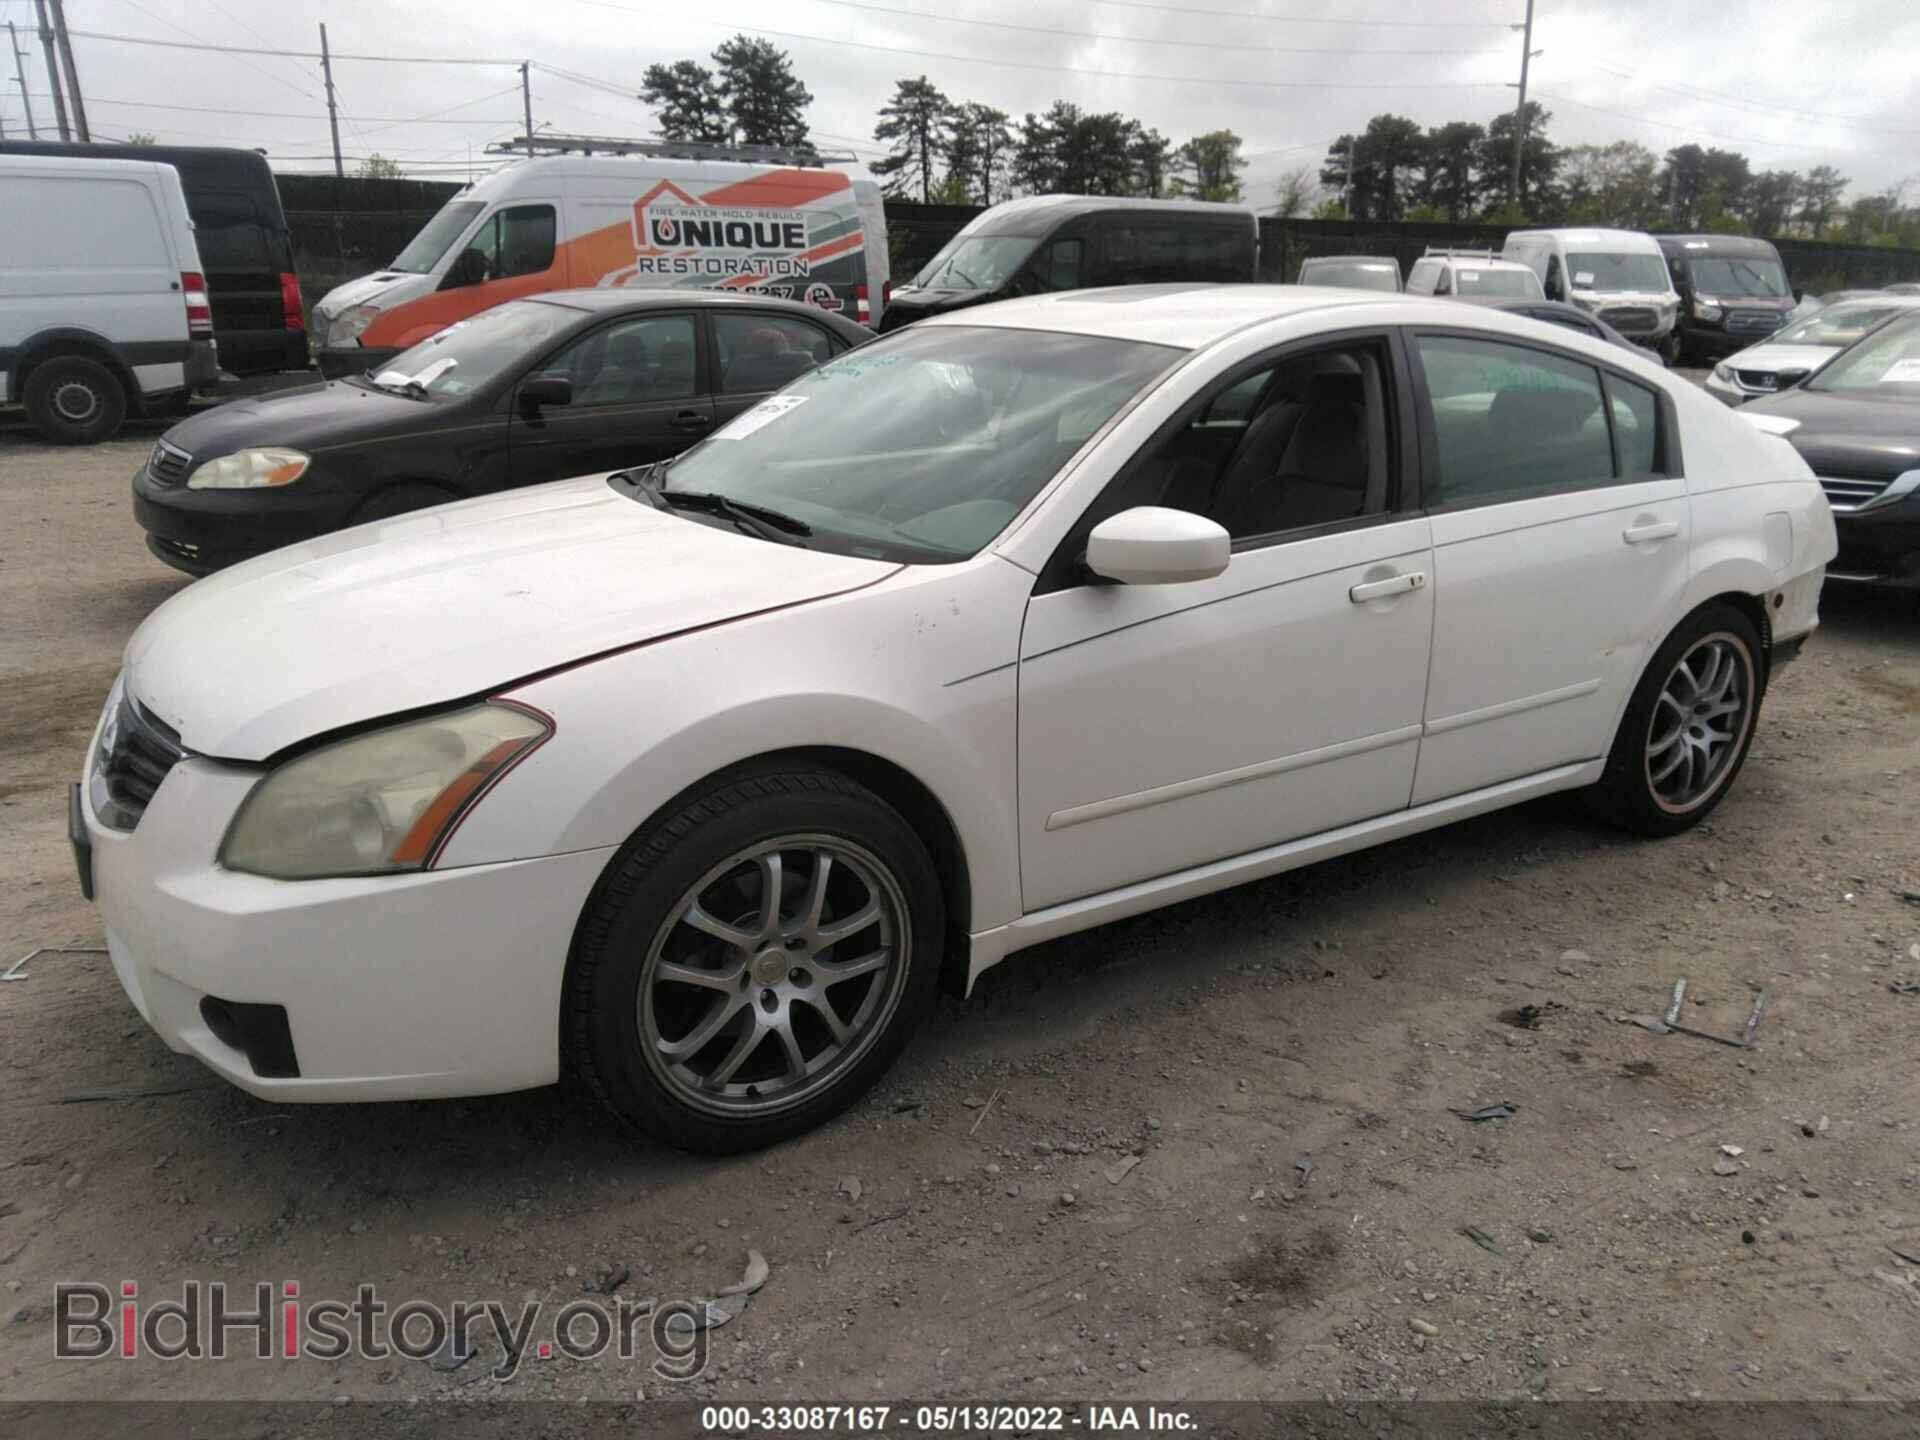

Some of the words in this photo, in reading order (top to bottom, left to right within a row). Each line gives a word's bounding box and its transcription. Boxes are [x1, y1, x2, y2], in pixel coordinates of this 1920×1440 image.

[650, 208, 673, 216] FIRE
[681, 208, 717, 217] WATER
[723, 209, 753, 218] MOLD
[759, 210, 803, 220] REBUILD
[651, 218, 805, 249] UNIQUE
[639, 257, 809, 275] RESTORATION
